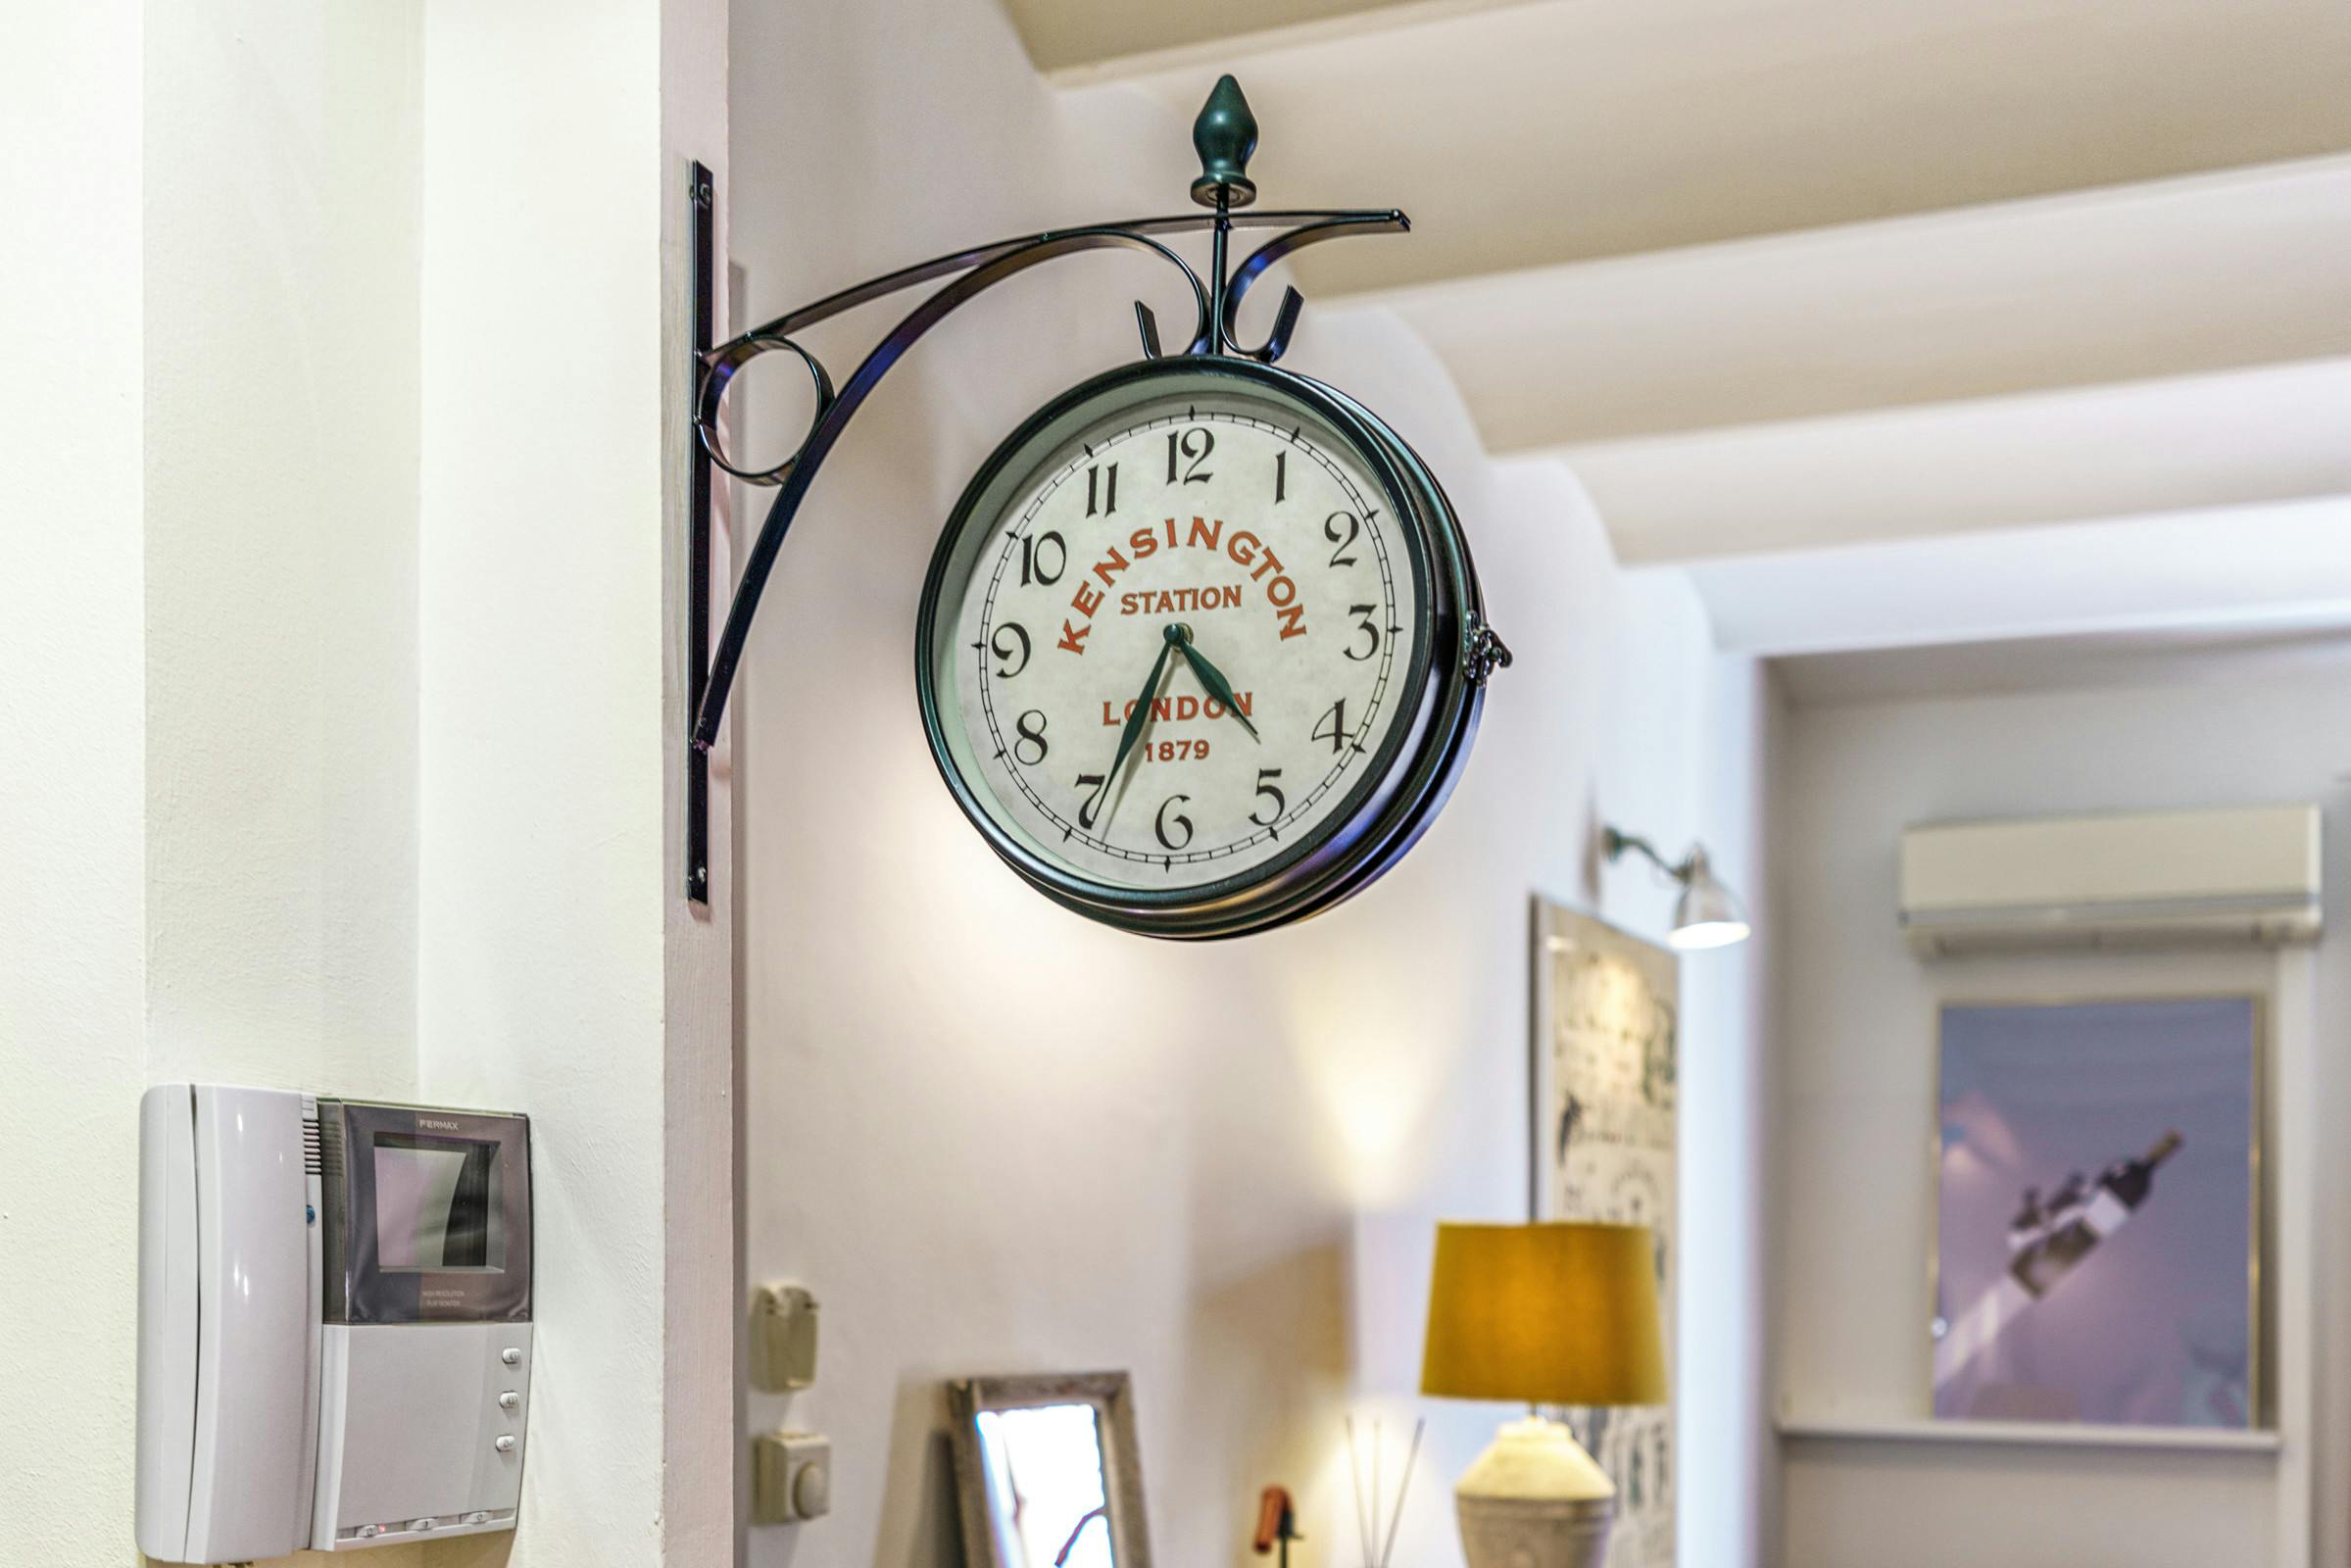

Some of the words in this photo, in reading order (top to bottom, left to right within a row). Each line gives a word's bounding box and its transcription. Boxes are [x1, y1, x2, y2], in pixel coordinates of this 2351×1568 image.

[1166, 427, 1215, 486] 12
[1275, 450, 1287, 505] 1
[1085, 462, 1118, 518] 11
[1020, 530, 1067, 588] 10
[1323, 511, 1359, 568] 2
[1057, 515, 1307, 656] KENSINGTON
[1120, 584, 1243, 616] STATION
[991, 622, 1032, 678] 9
[1343, 604, 1380, 662] 3
[1013, 710, 1049, 765] 8
[1145, 739, 1210, 762] 1879
[1310, 697, 1355, 756] 4
[1074, 773, 1105, 830] 7
[1154, 794, 1194, 850] 6
[1248, 767, 1286, 826] 5
[418, 1118, 460, 1131] FERMAX
